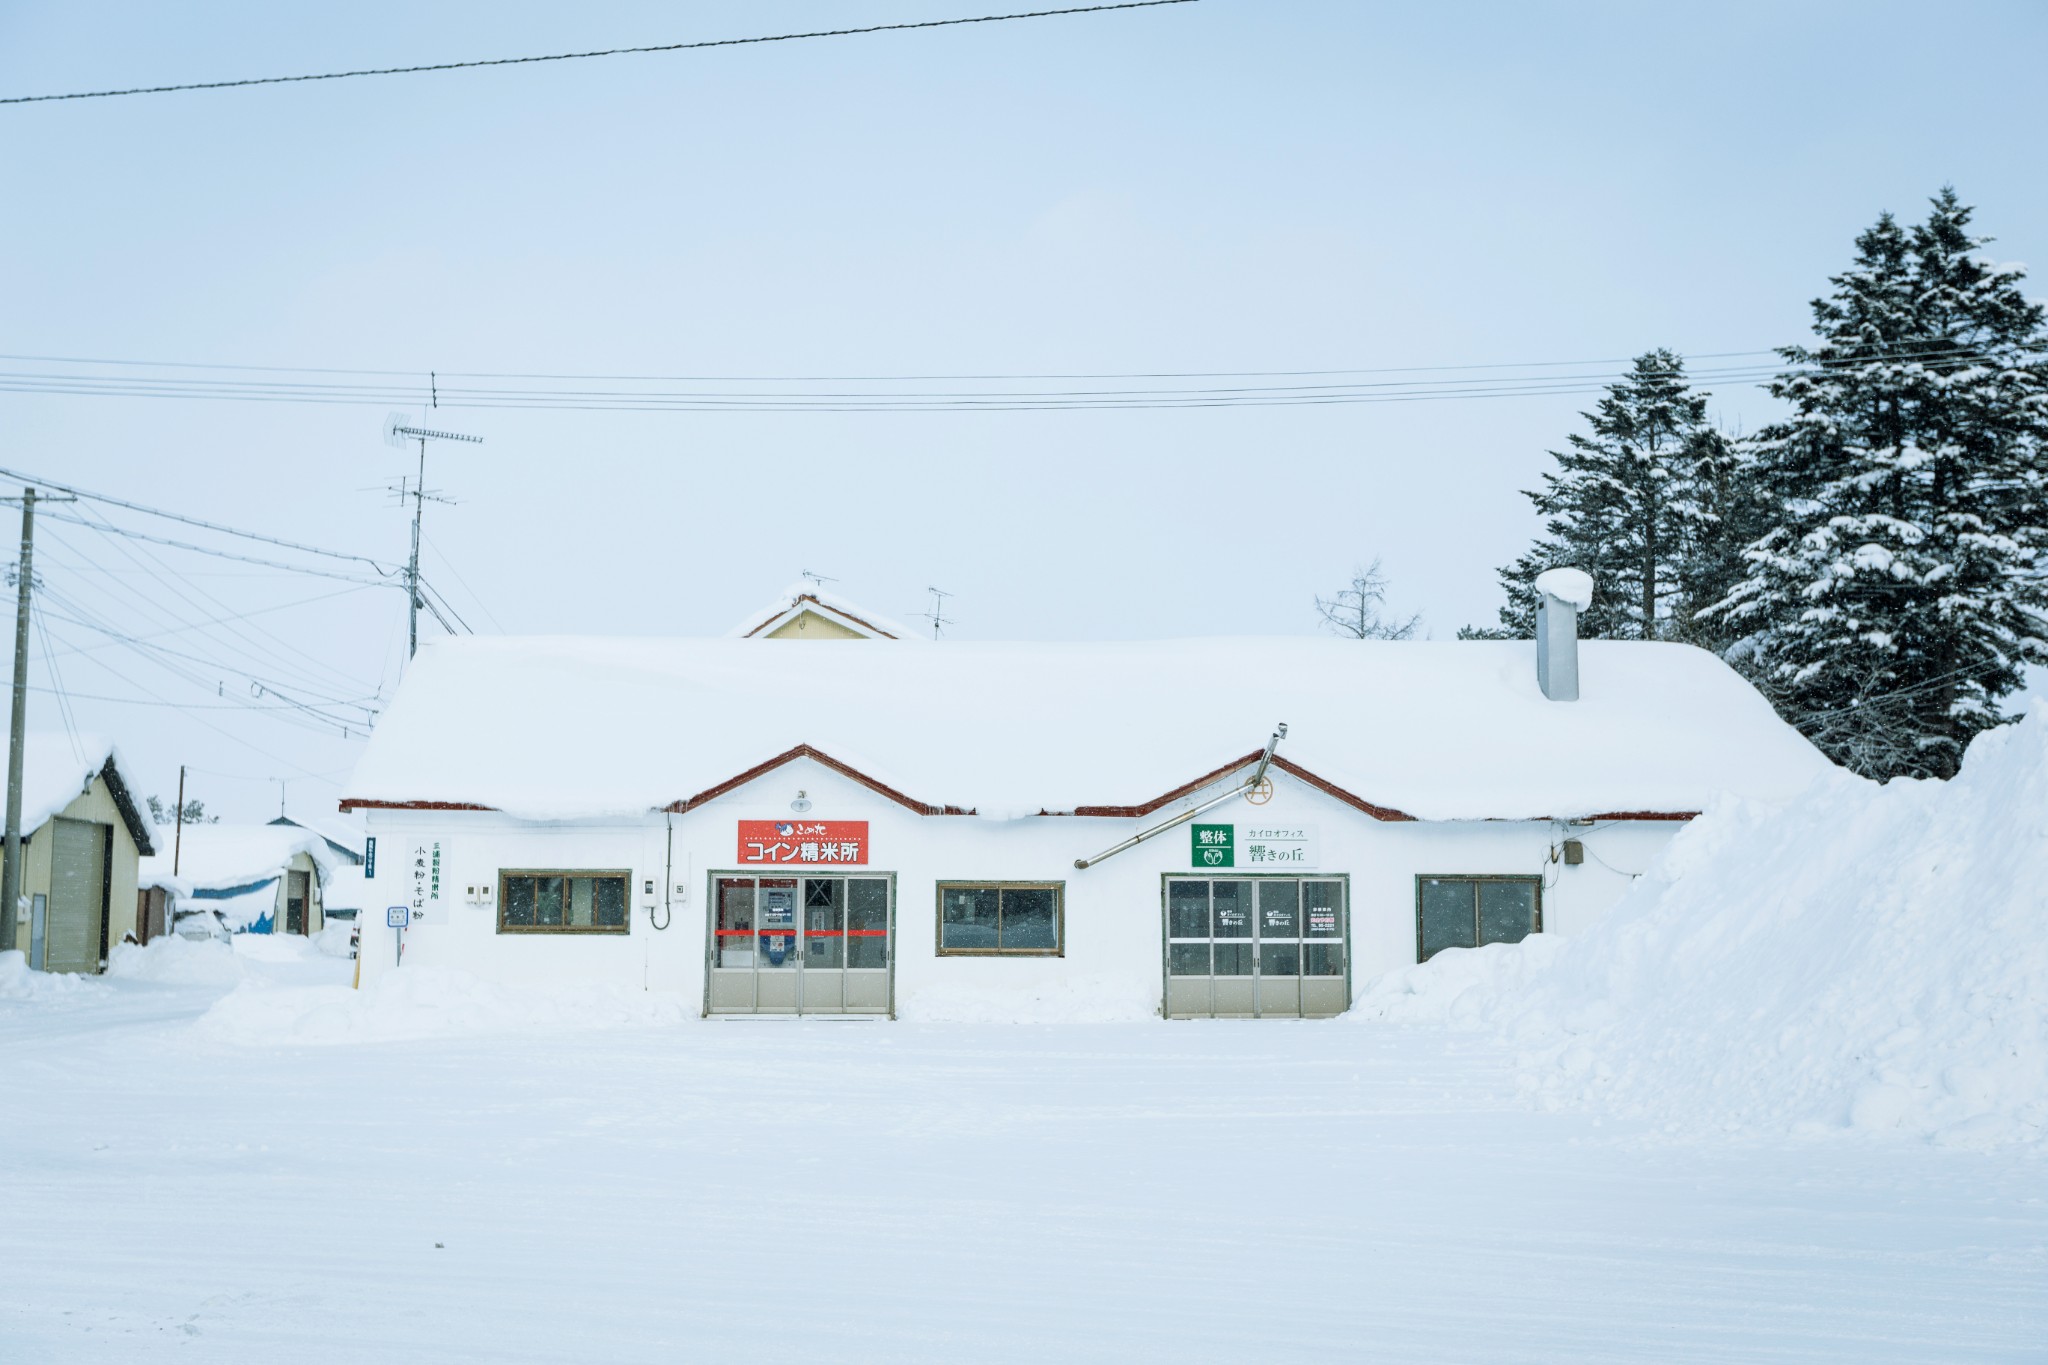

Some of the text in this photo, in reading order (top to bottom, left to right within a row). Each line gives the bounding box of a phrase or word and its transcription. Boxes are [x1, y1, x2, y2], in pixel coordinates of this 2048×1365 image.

[1199, 830, 1227, 844] 整体
[1249, 829, 1304, 837] カイロオフィス
[746, 841, 860, 862] コイン精米所
[1249, 845, 1304, 862] 響きの丘
[412, 846, 426, 920] 小麦粉・そば粉
